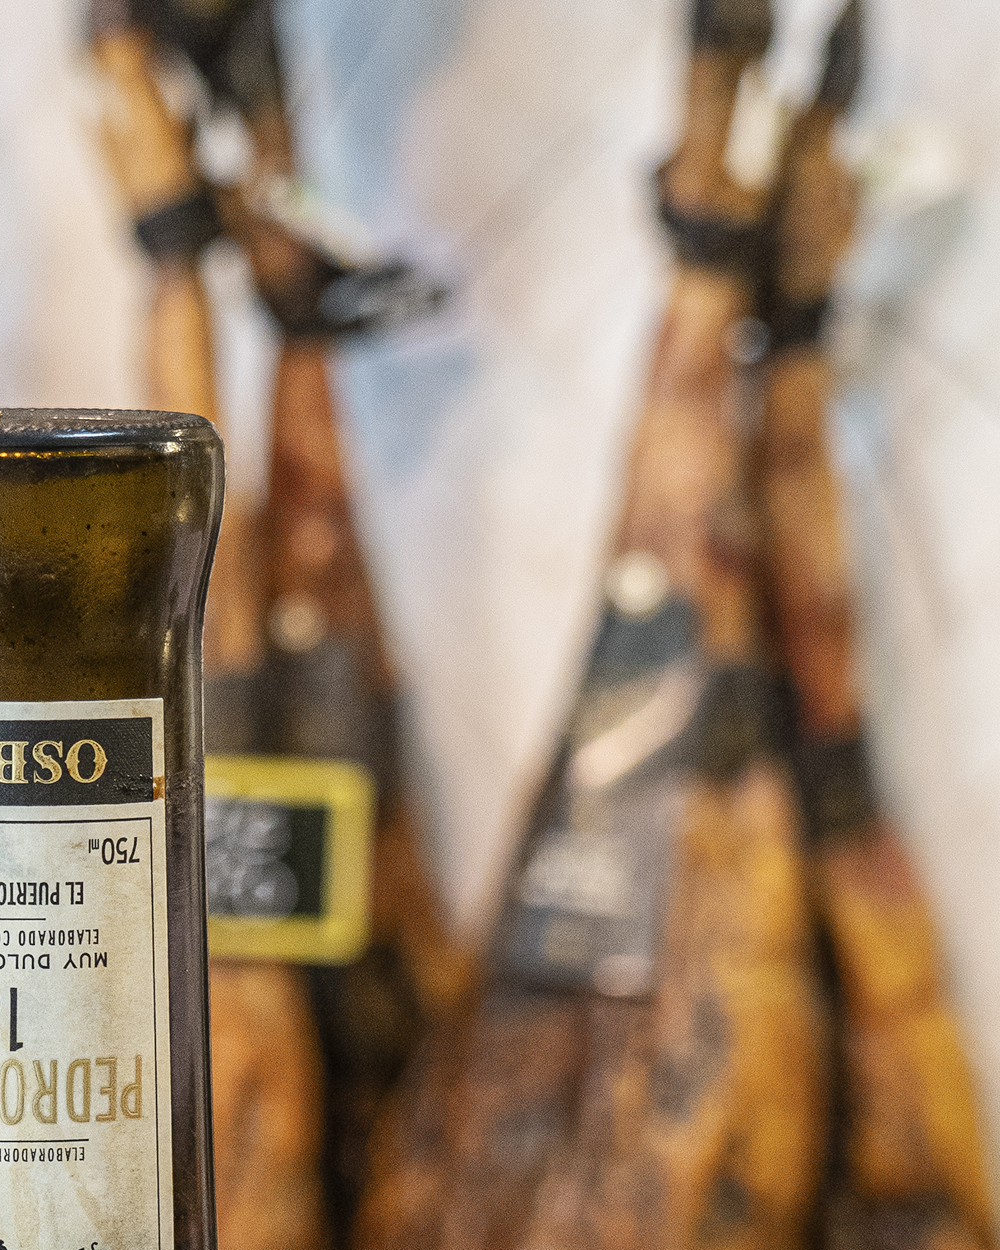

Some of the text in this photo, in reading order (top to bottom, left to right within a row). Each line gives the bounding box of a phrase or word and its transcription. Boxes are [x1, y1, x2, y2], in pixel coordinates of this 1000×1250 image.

[66, 882, 84, 905] EL
[18, 929, 99, 944] ELABORADO
[64, 952, 108, 968] MUY
[0, 1055, 143, 1126] PEDRO
